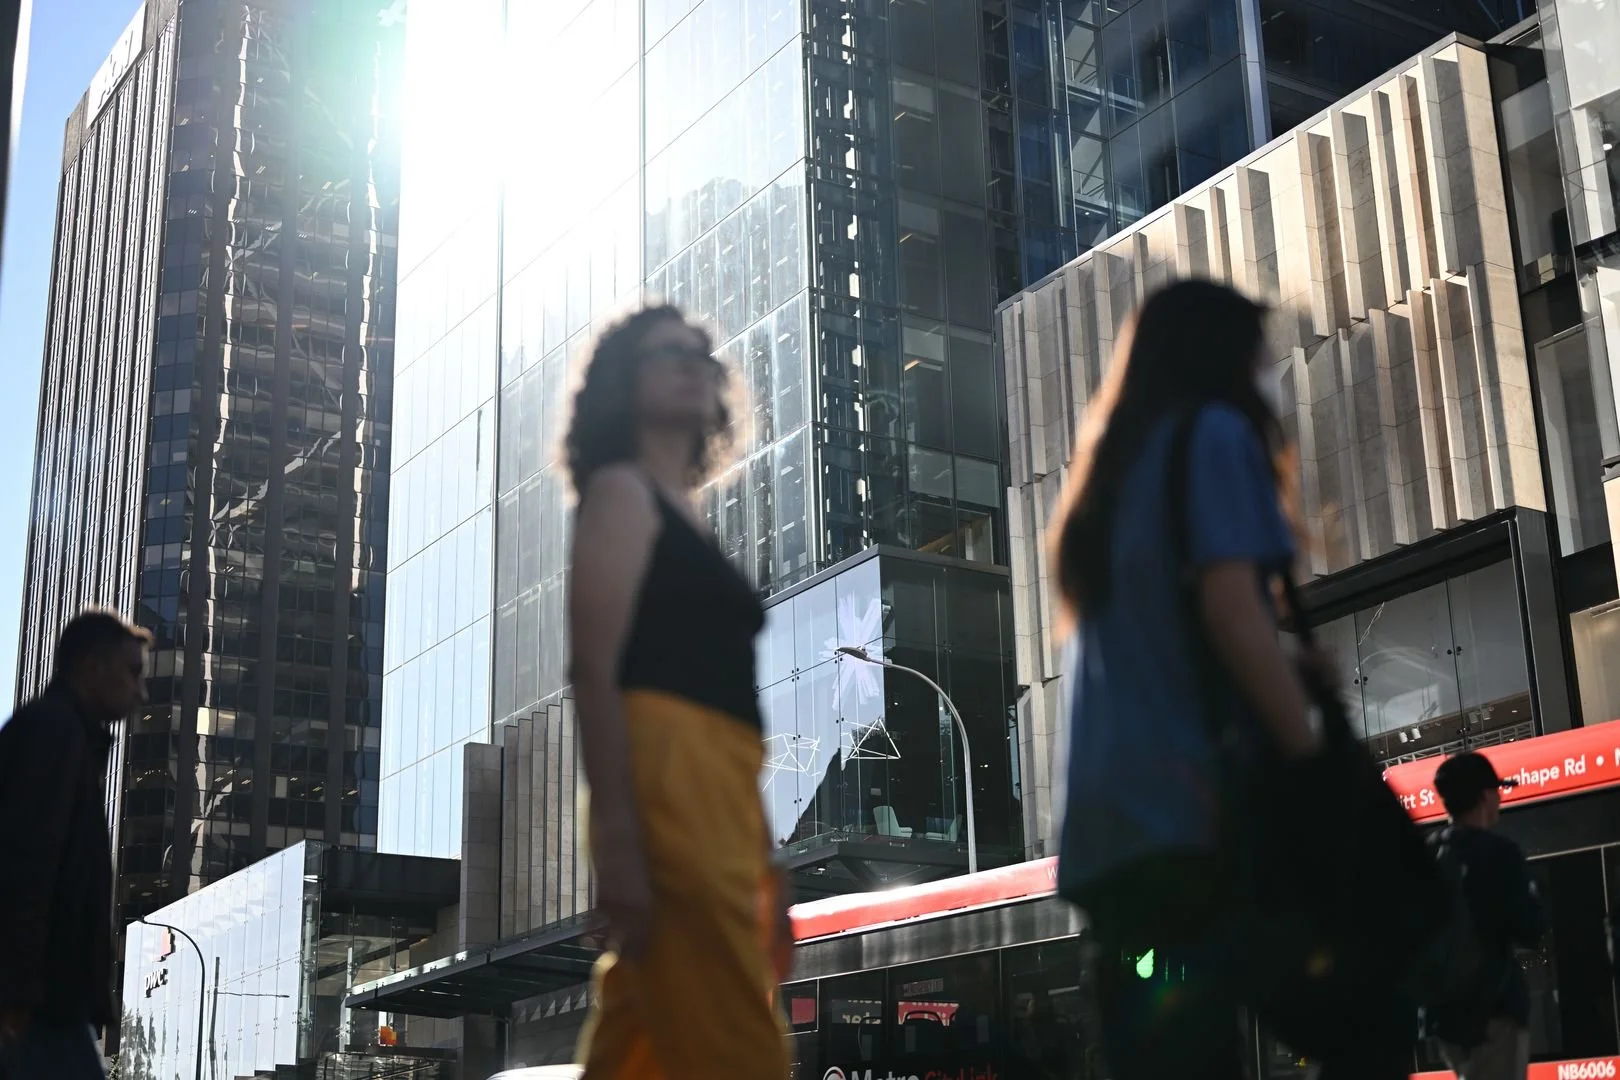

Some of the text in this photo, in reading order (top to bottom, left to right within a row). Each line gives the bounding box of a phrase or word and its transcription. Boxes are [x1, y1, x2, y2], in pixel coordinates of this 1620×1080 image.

[1399, 754, 1586, 809] itt St gahape Rd
[1557, 1060, 1616, 1080] NB6006
